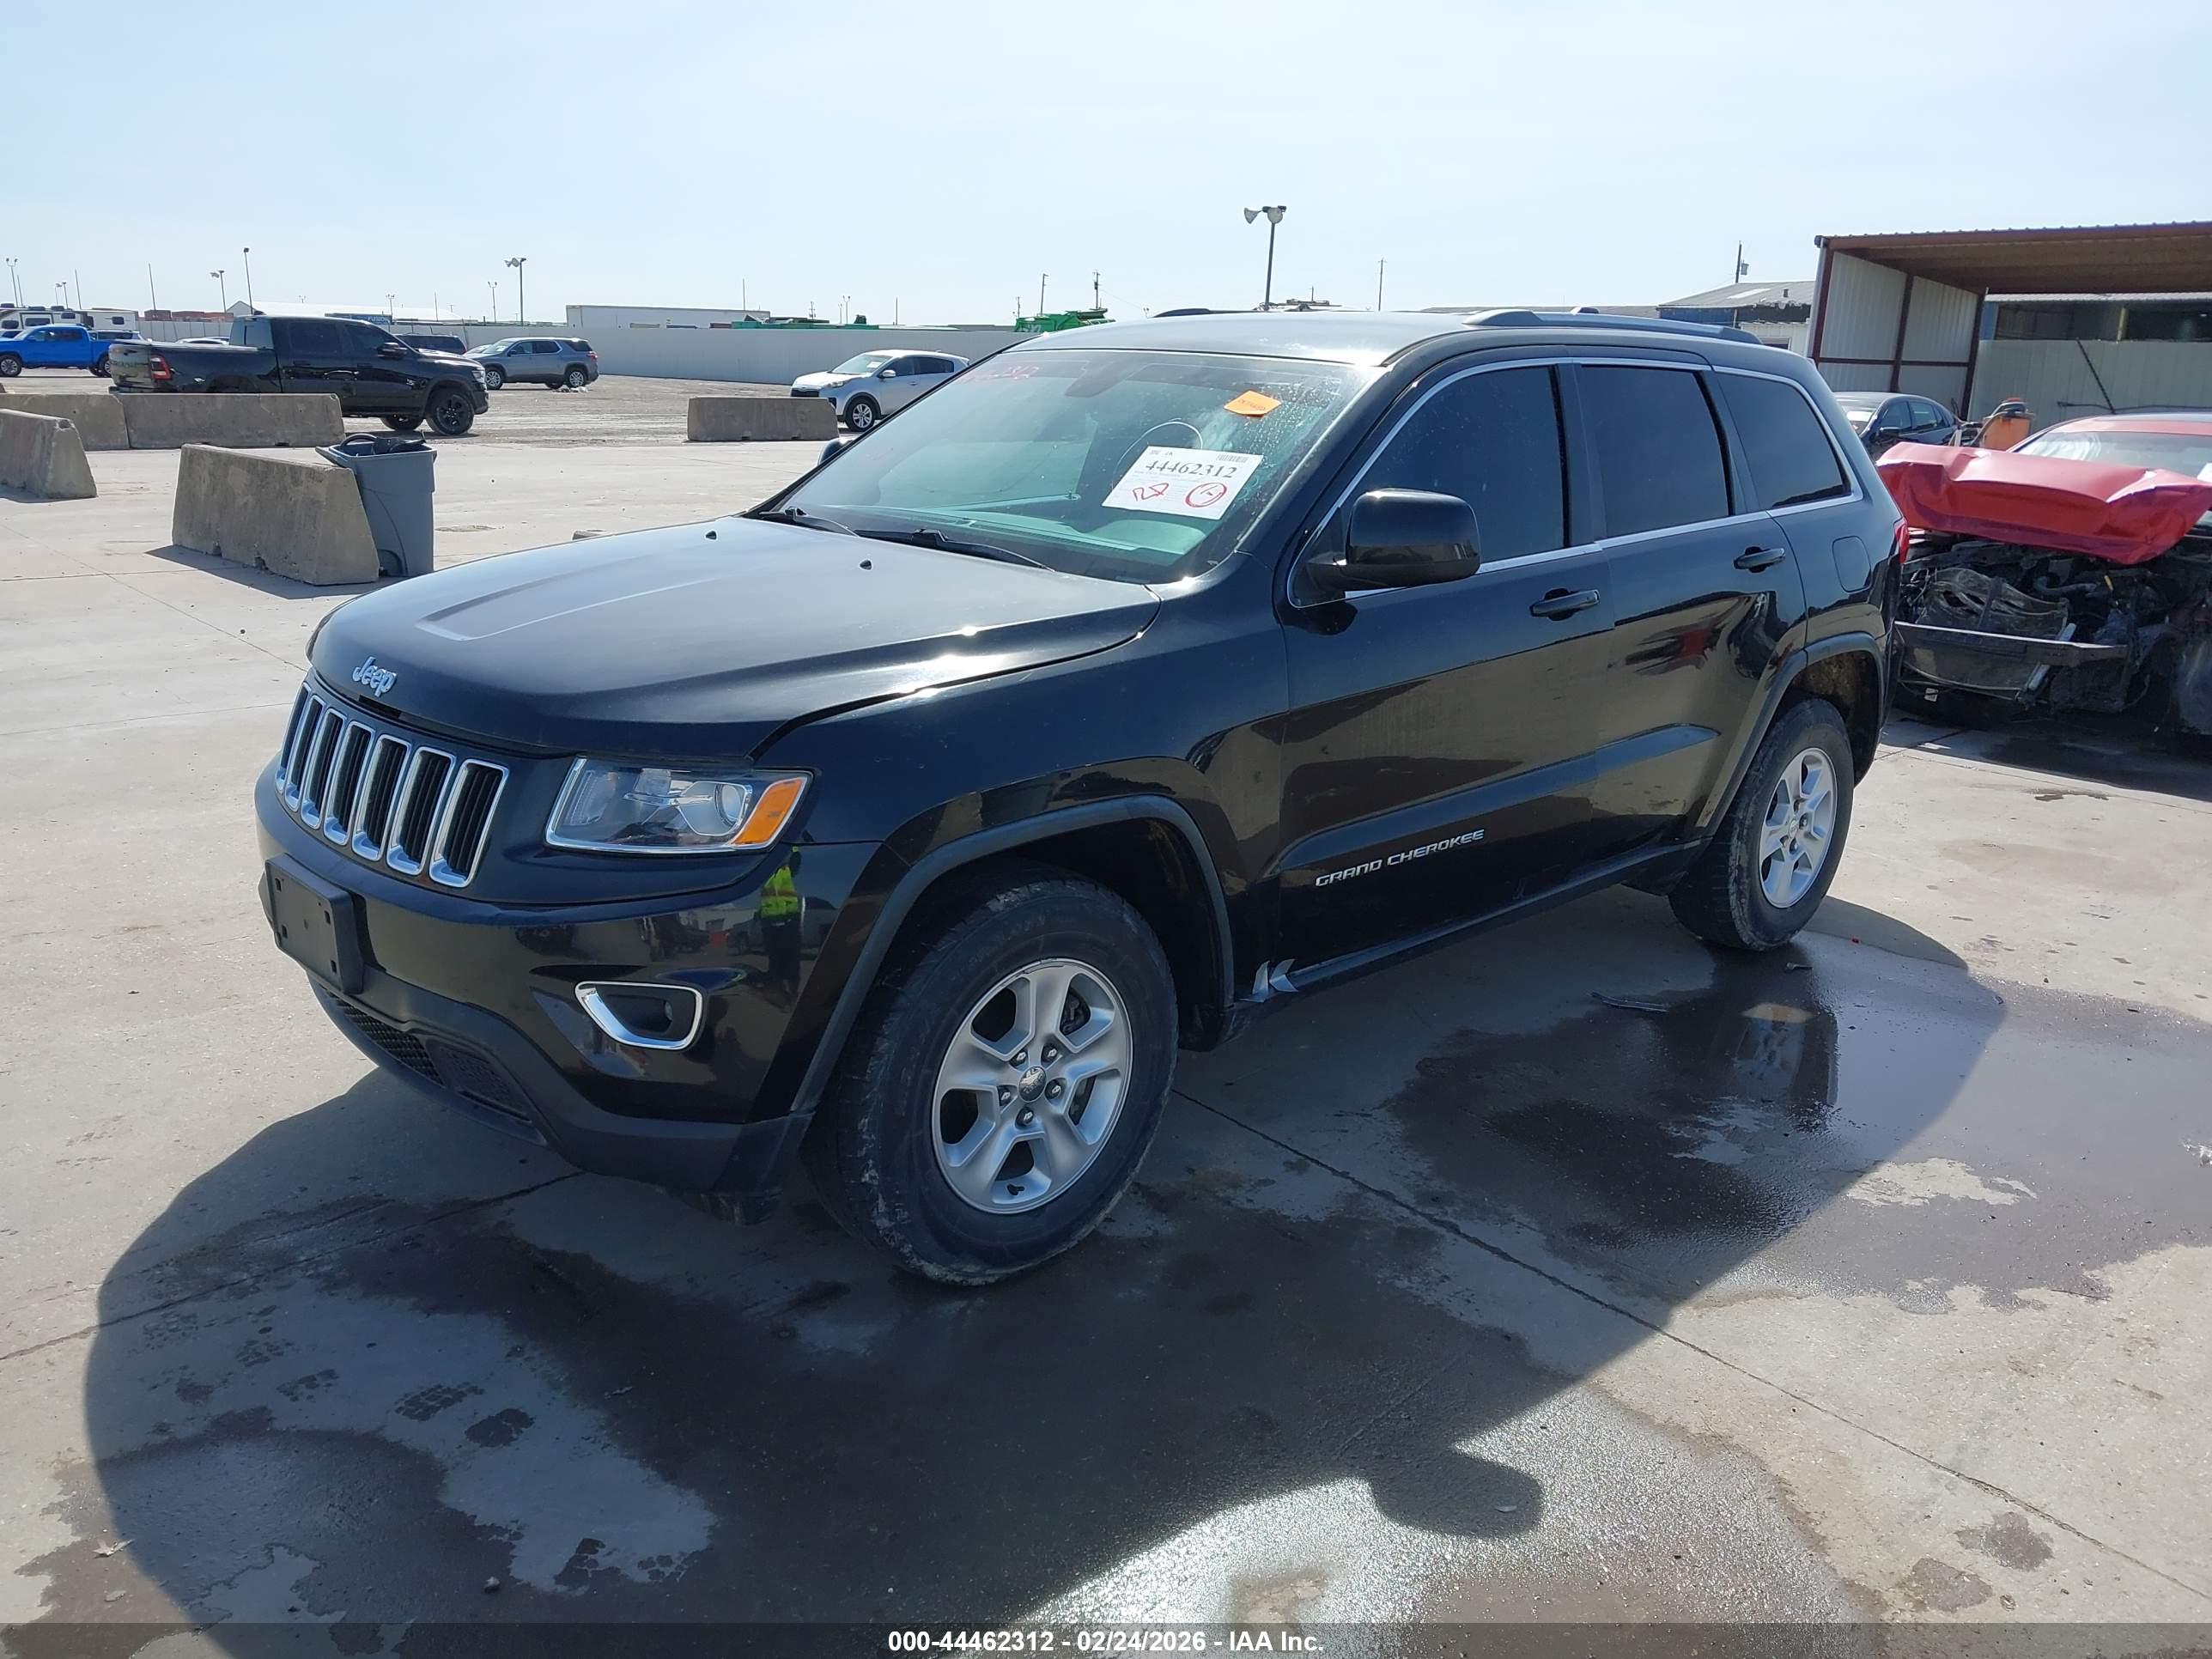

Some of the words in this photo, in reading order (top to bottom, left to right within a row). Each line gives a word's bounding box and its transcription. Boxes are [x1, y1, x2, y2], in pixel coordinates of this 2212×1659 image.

[1145, 459, 1237, 478] 44462312
[352, 656, 397, 697] Jeep
[1315, 859, 1382, 888] GRAND
[1387, 829, 1485, 866] CHEROKEE
